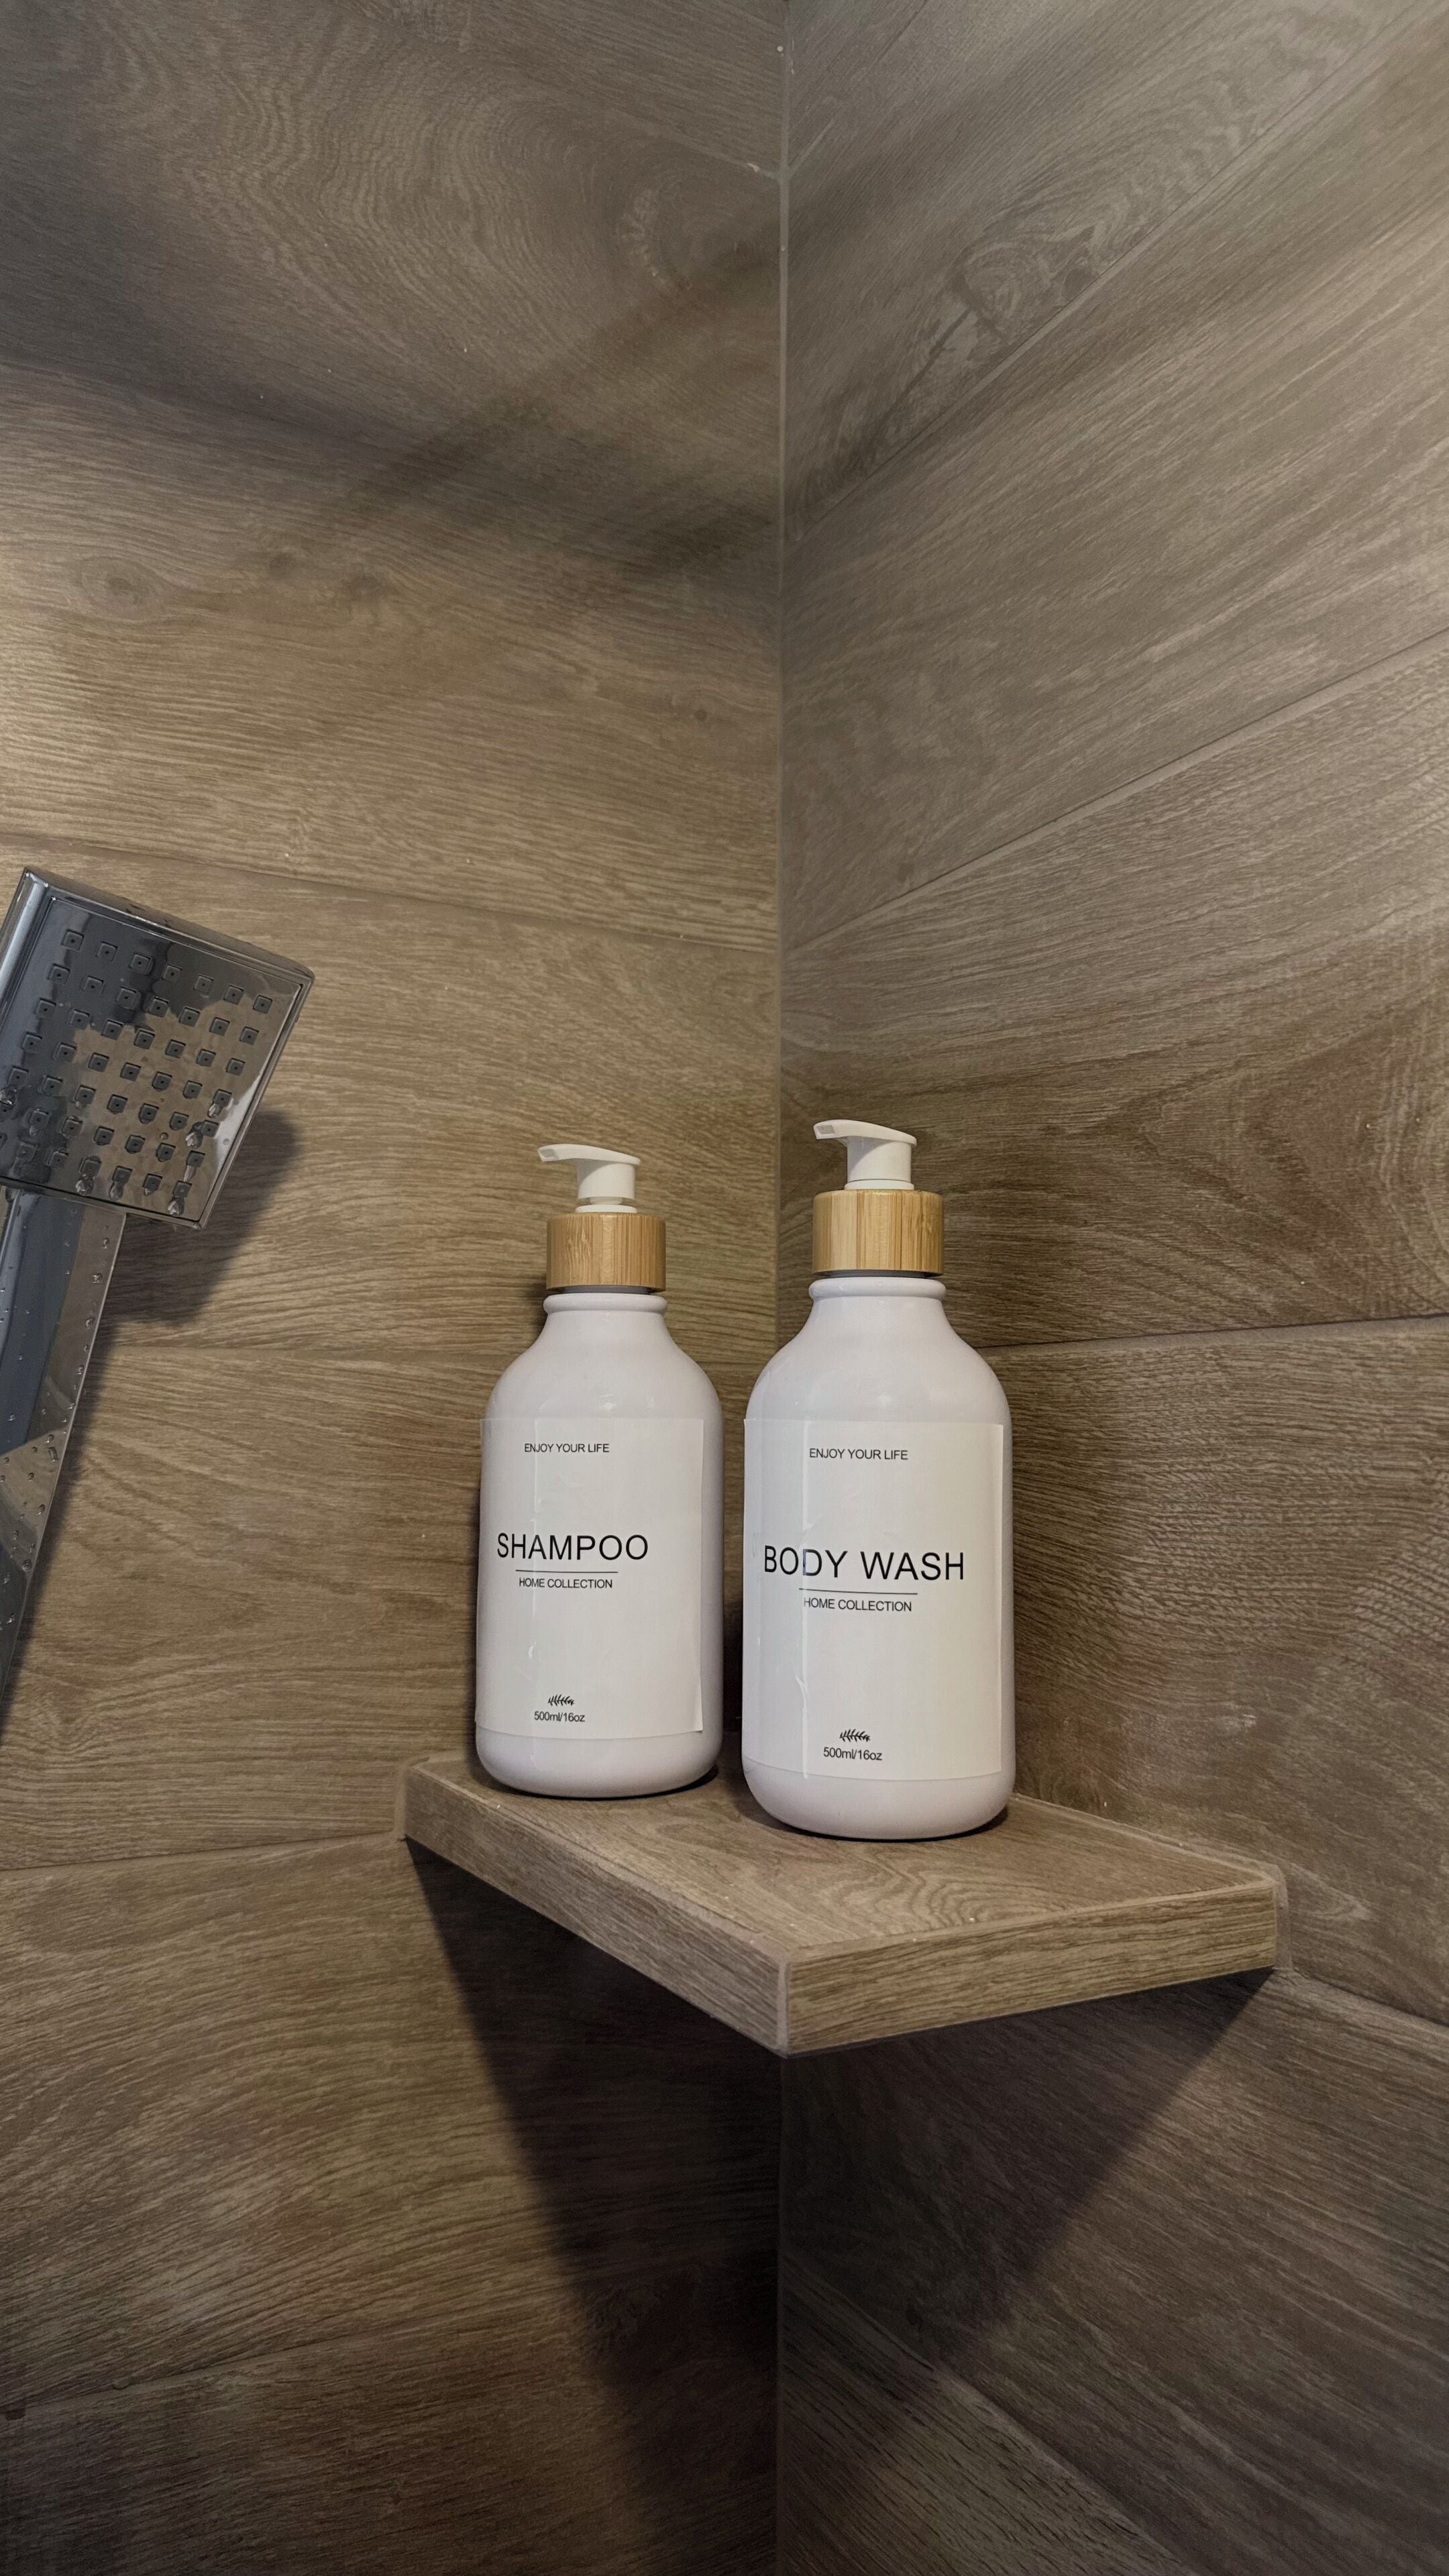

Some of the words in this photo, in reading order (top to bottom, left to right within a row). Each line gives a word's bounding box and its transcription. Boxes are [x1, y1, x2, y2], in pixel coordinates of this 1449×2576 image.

[524, 1443, 554, 1453] ENJOY
[555, 1443, 586, 1453] YOUR
[588, 1443, 610, 1453] LIFE
[809, 1448, 845, 1459] ENJOY
[847, 1448, 881, 1460] YOUR
[884, 1449, 908, 1460] LIFE
[496, 1532, 649, 1561] SHAMPOO
[764, 1545, 848, 1578] BODY
[860, 1551, 964, 1581] WASH
[519, 1577, 545, 1588] HOME
[547, 1578, 612, 1589] COLLECTION
[804, 1597, 835, 1609] HOME
[837, 1599, 912, 1612] COLLECTION
[534, 1711, 586, 1723] 500ml/16oz
[823, 1746, 883, 1761] 500ml/16oz
